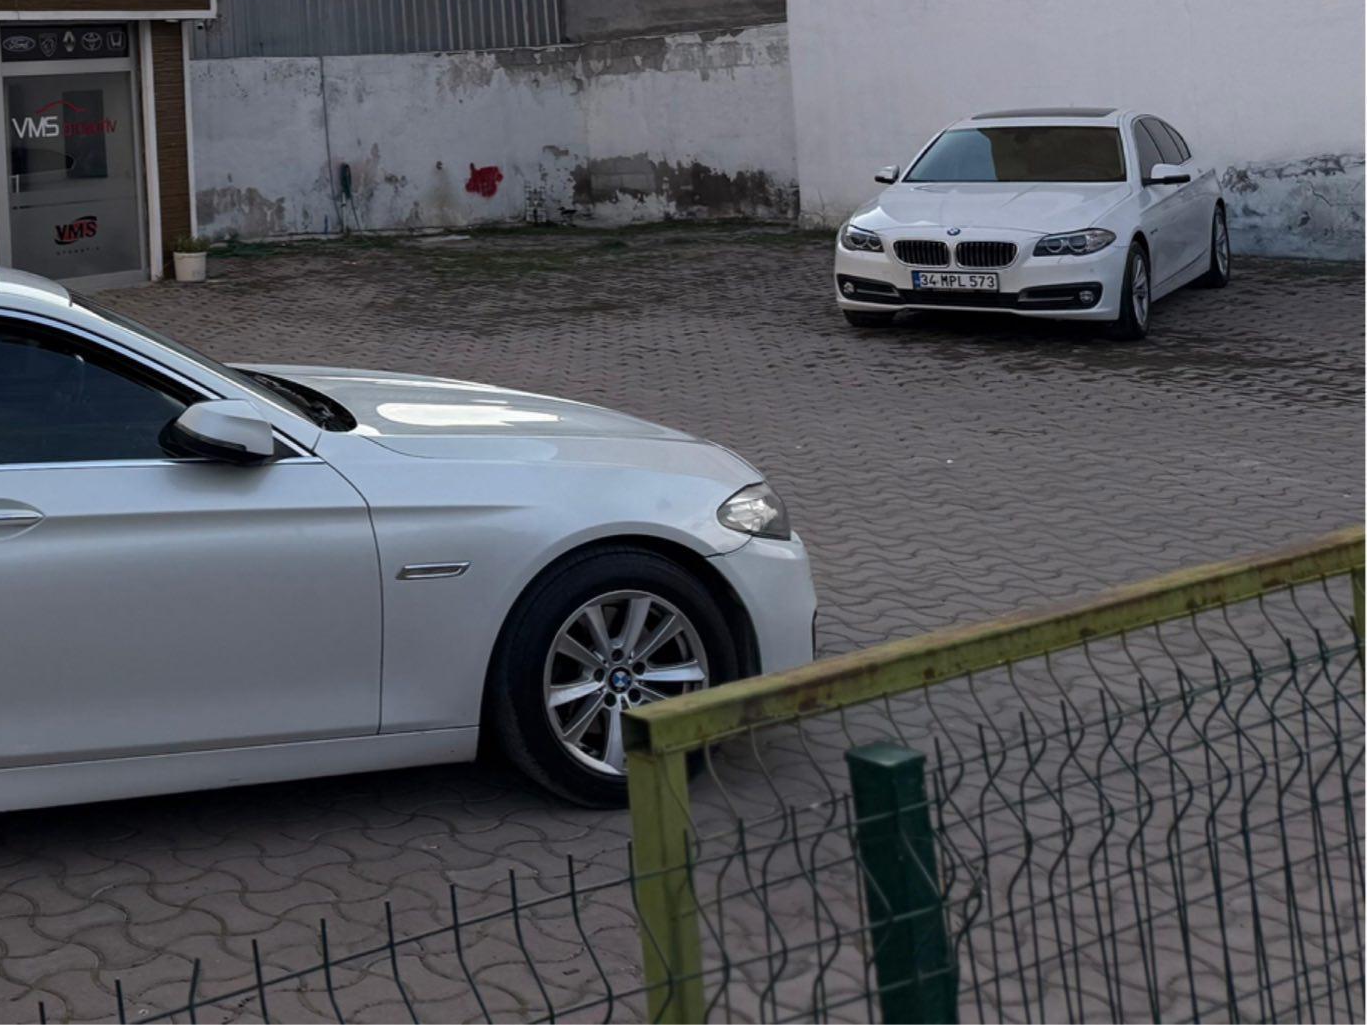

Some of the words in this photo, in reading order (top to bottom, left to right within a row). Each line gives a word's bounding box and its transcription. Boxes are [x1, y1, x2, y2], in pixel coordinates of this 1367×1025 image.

[12, 116, 59, 138] VMS
[55, 221, 97, 240] VMS
[920, 274, 937, 286] 34
[969, 275, 995, 288] 573
